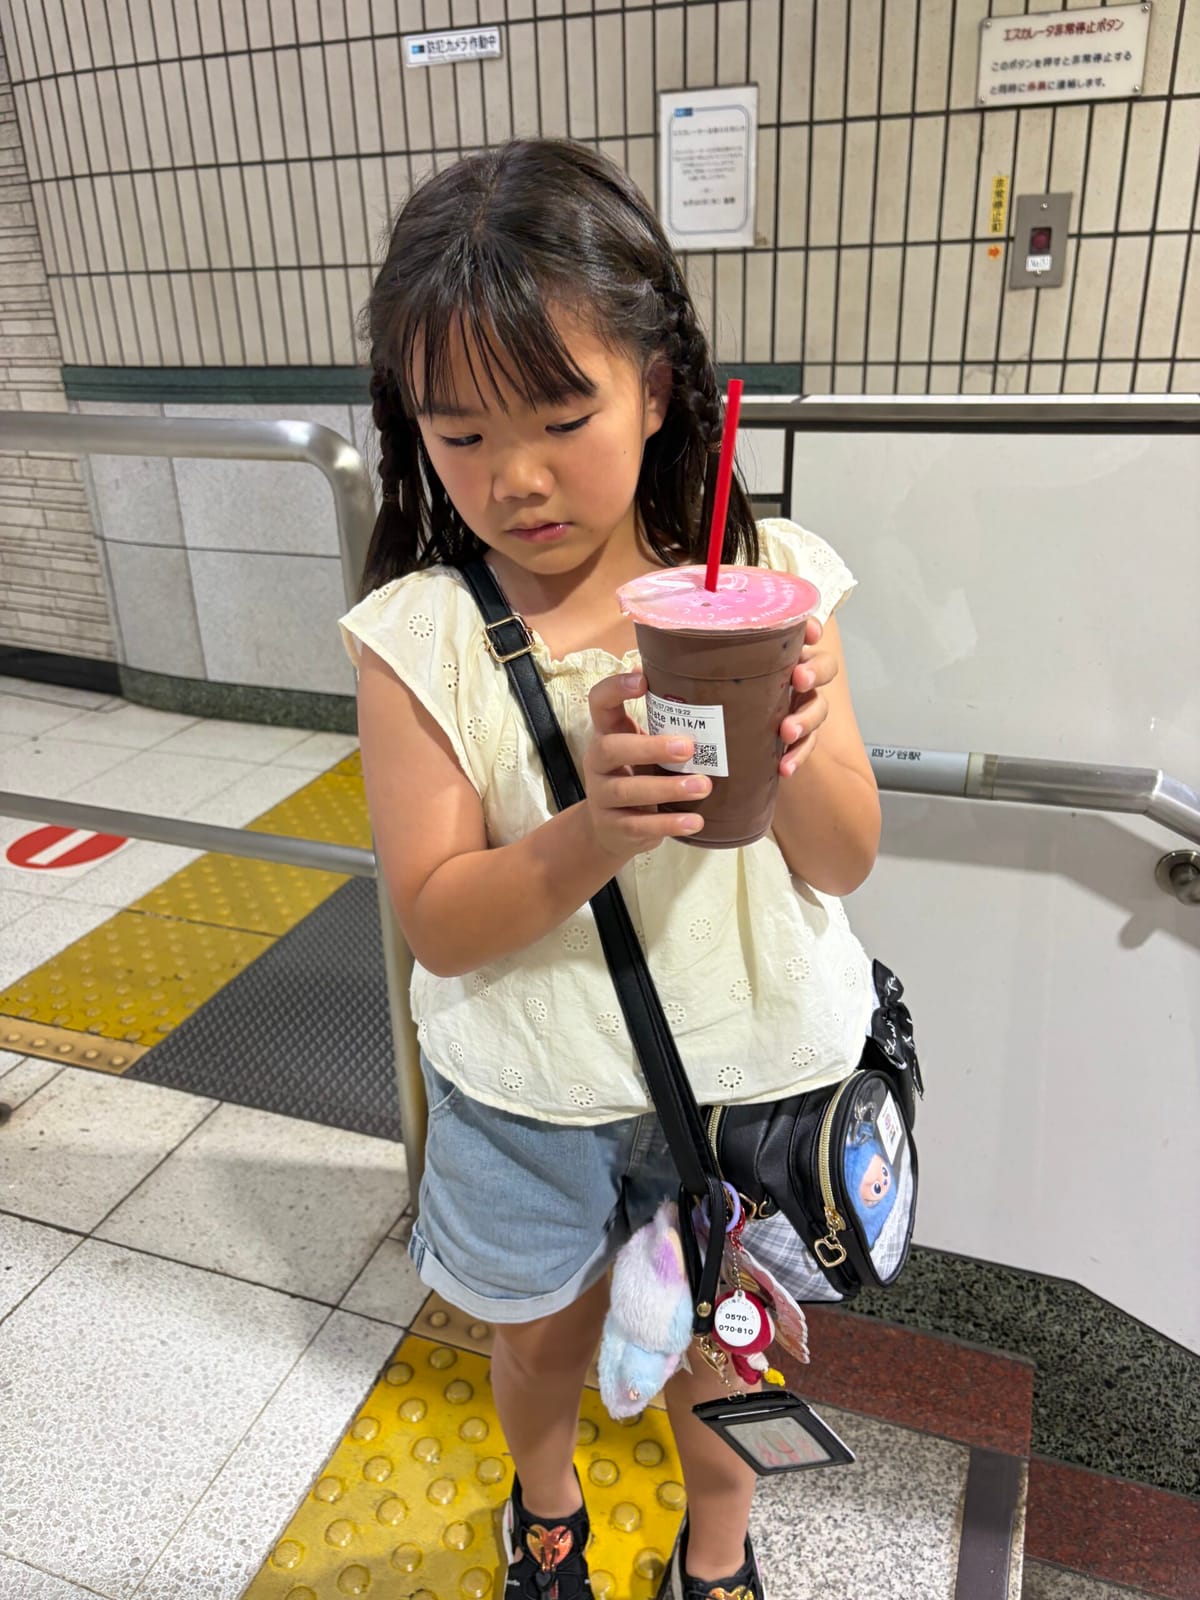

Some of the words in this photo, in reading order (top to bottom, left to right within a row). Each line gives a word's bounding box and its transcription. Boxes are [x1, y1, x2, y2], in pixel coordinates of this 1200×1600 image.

[1003, 17, 1125, 42] エスカレータ非常停止ボタン
[670, 715, 707, 730] Milk/M
[871, 747, 921, 761] 四ツ谷駅
[718, 1324, 754, 1336] 070-810
